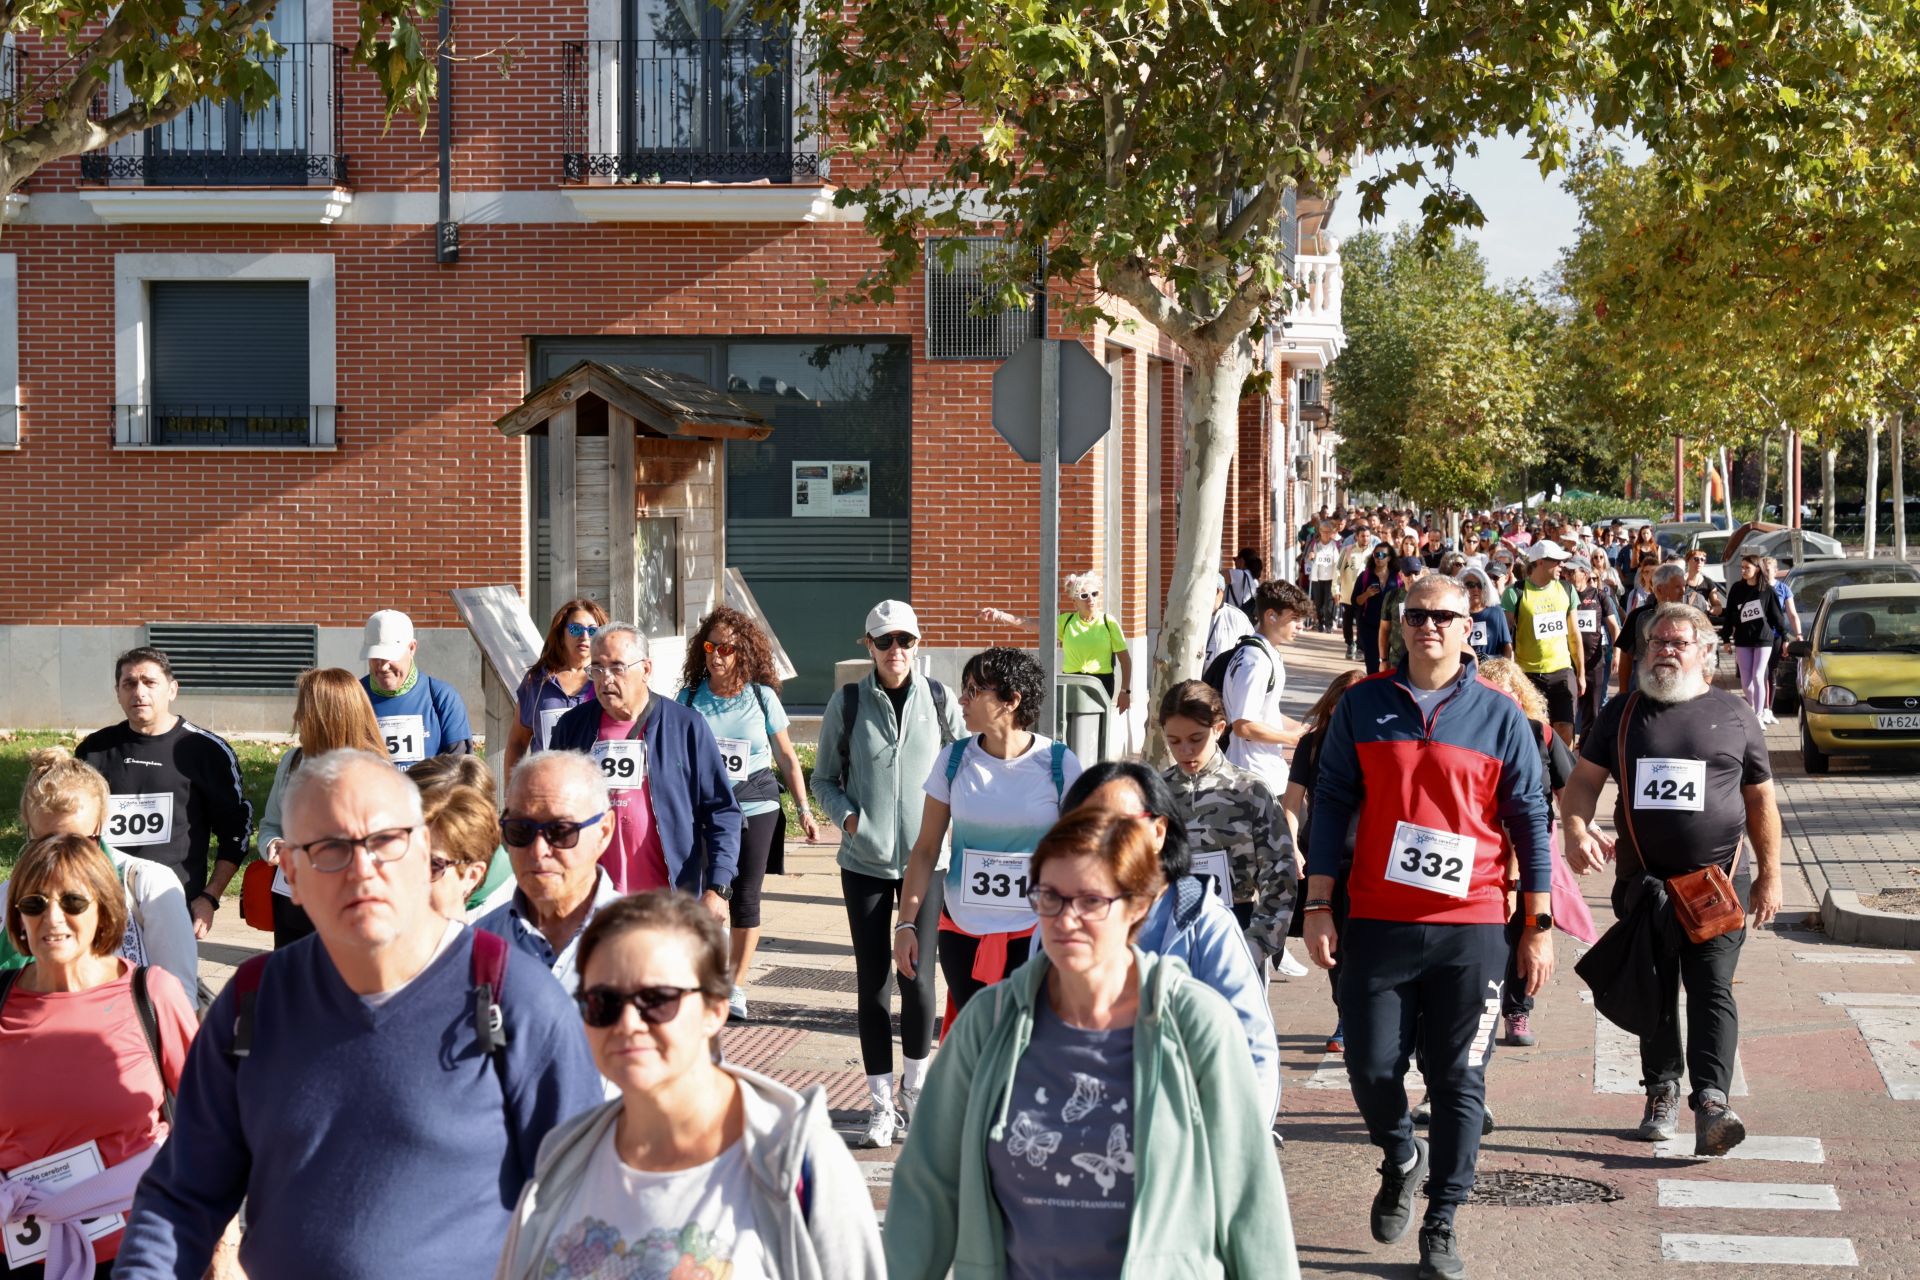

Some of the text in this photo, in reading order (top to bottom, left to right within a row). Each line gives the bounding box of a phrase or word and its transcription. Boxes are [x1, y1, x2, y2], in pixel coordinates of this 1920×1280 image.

[1742, 607, 1760, 618] 426
[1538, 621, 1564, 633] 268
[1578, 619, 1593, 628] 94
[385, 734, 413, 754] 51
[123, 757, 163, 767] Champion
[601, 757, 635, 778] 89
[1643, 779, 1696, 801] 424
[109, 812, 165, 836] 309
[1400, 847, 1464, 883] 332
[972, 872, 1027, 899] 331
